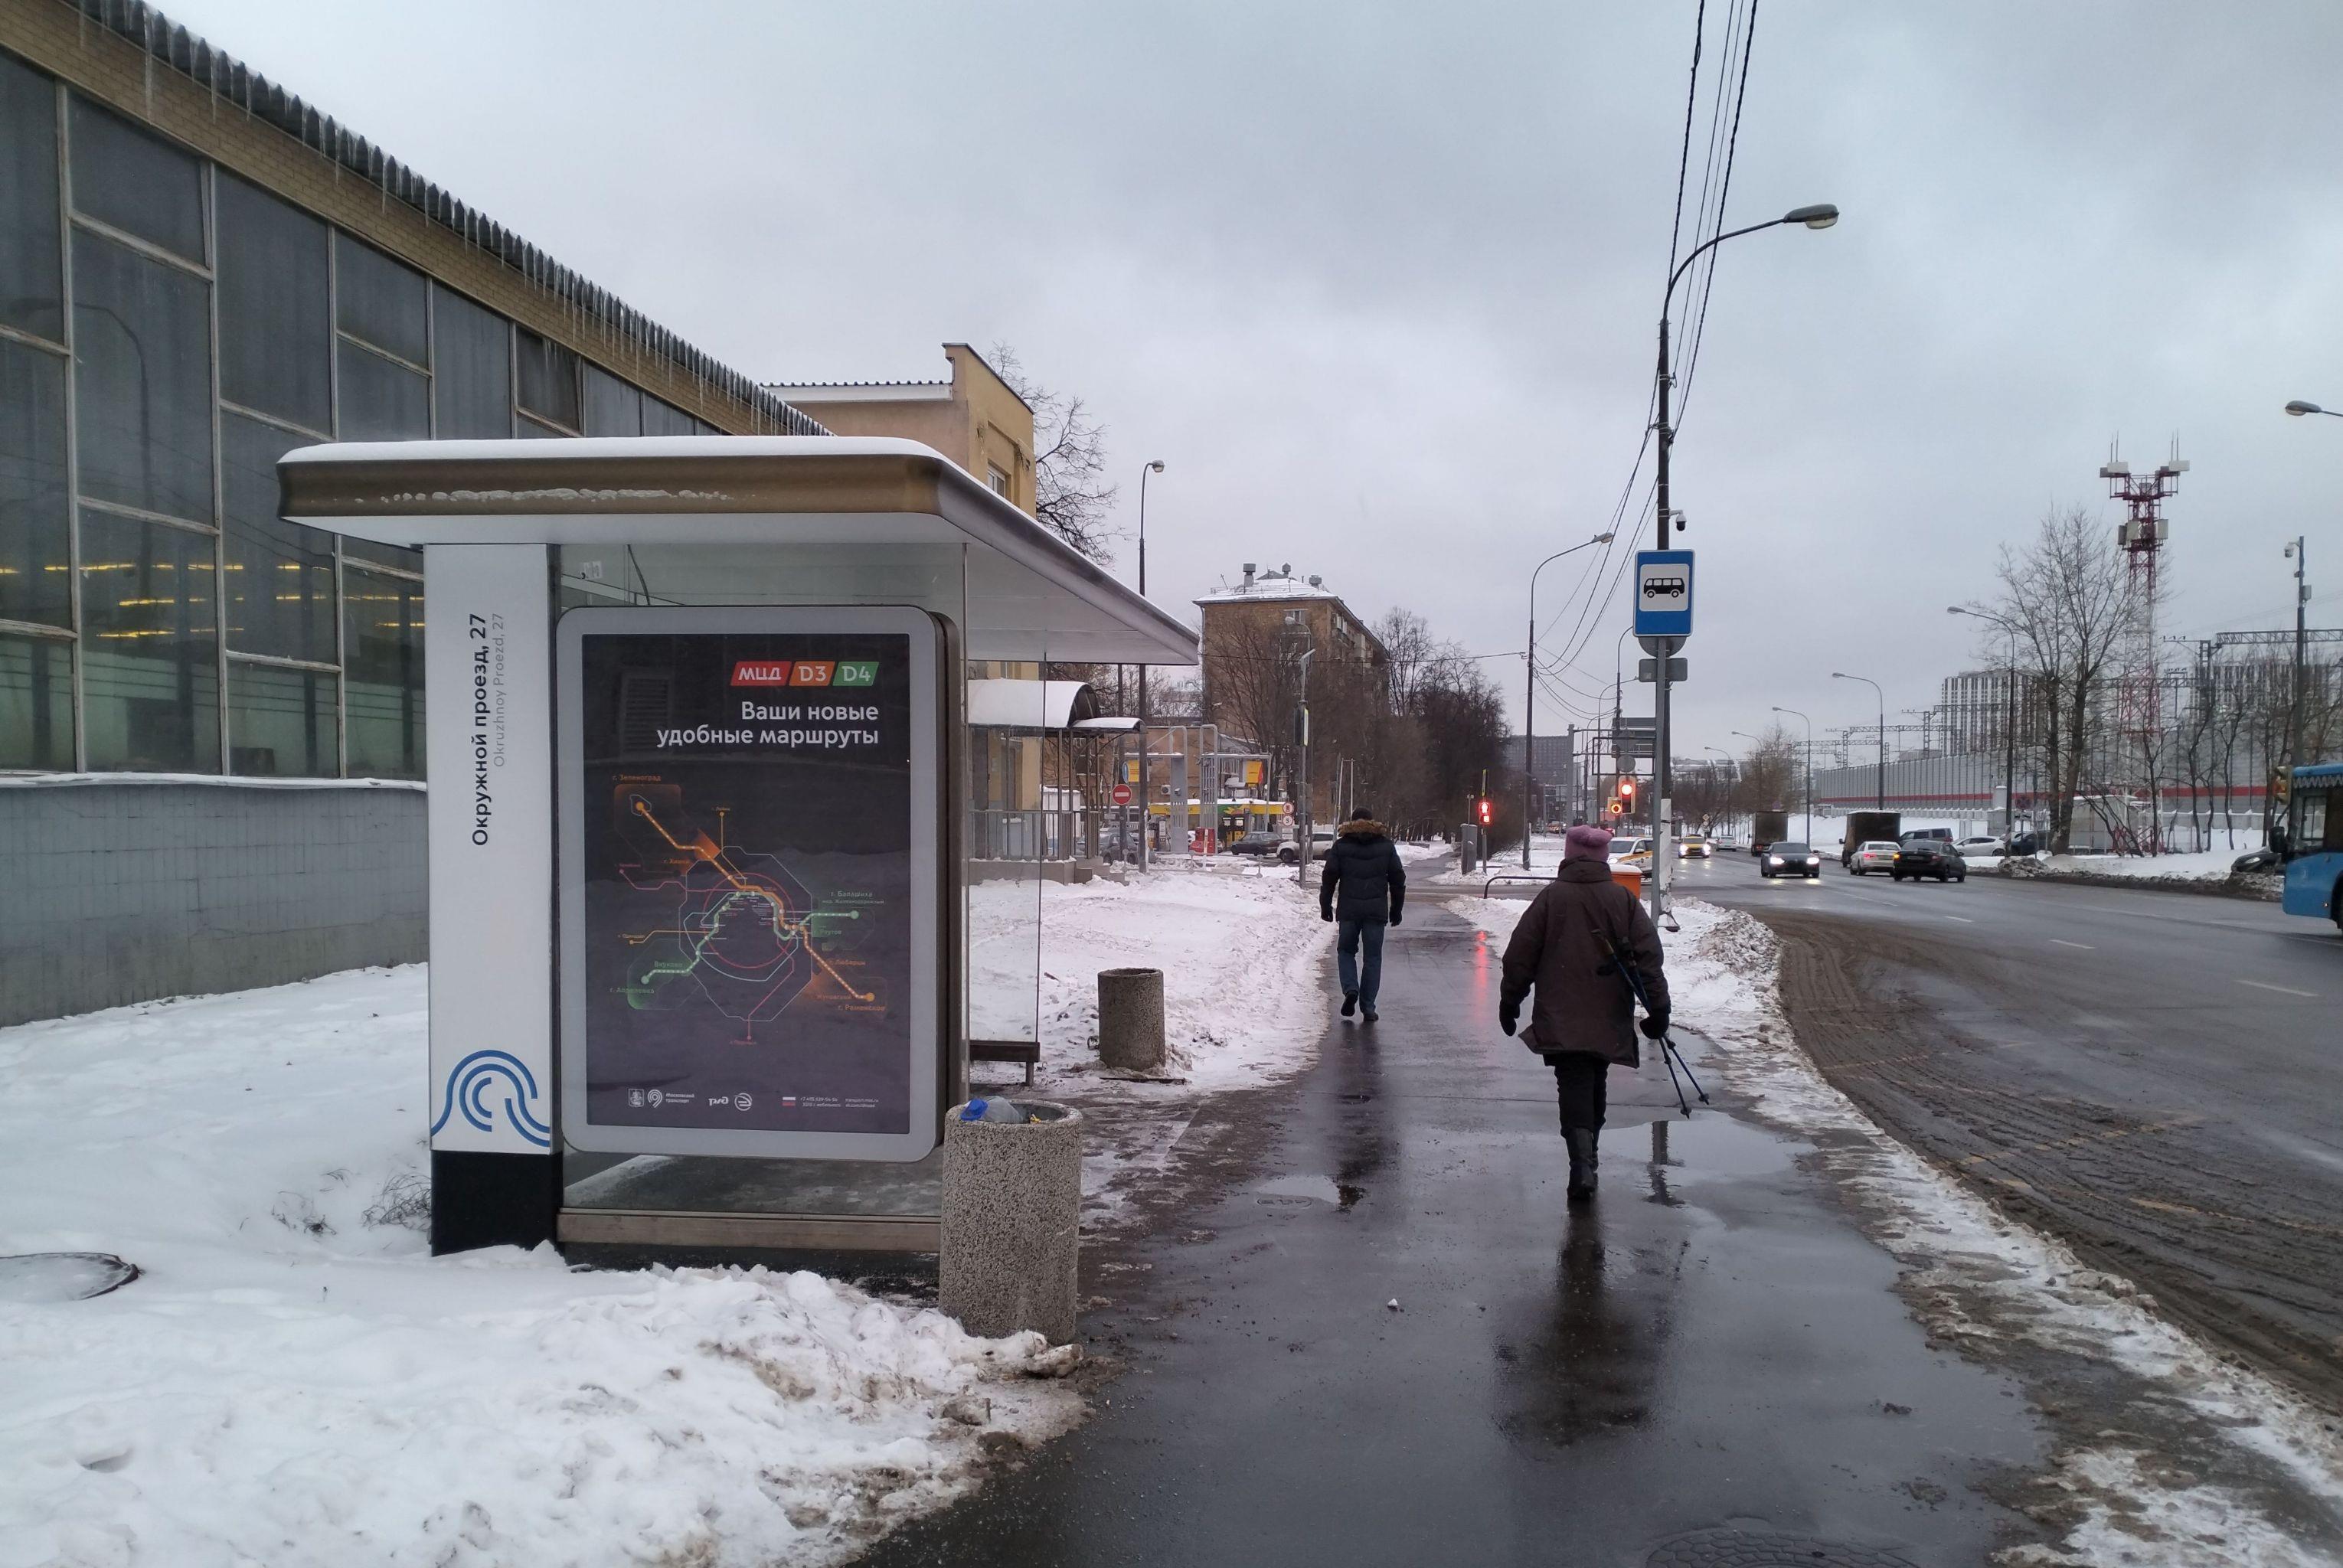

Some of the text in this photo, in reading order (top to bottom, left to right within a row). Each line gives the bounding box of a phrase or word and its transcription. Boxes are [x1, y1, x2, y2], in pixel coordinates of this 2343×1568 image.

[737, 665, 871, 681] МЦД D3 D4
[492, 613, 507, 767] Okruzhnoy Proezd, 27
[741, 701, 879, 720] Ваши новые
[469, 613, 492, 845] Окружной проезд, 27
[657, 724, 879, 748] удобные маршруты
